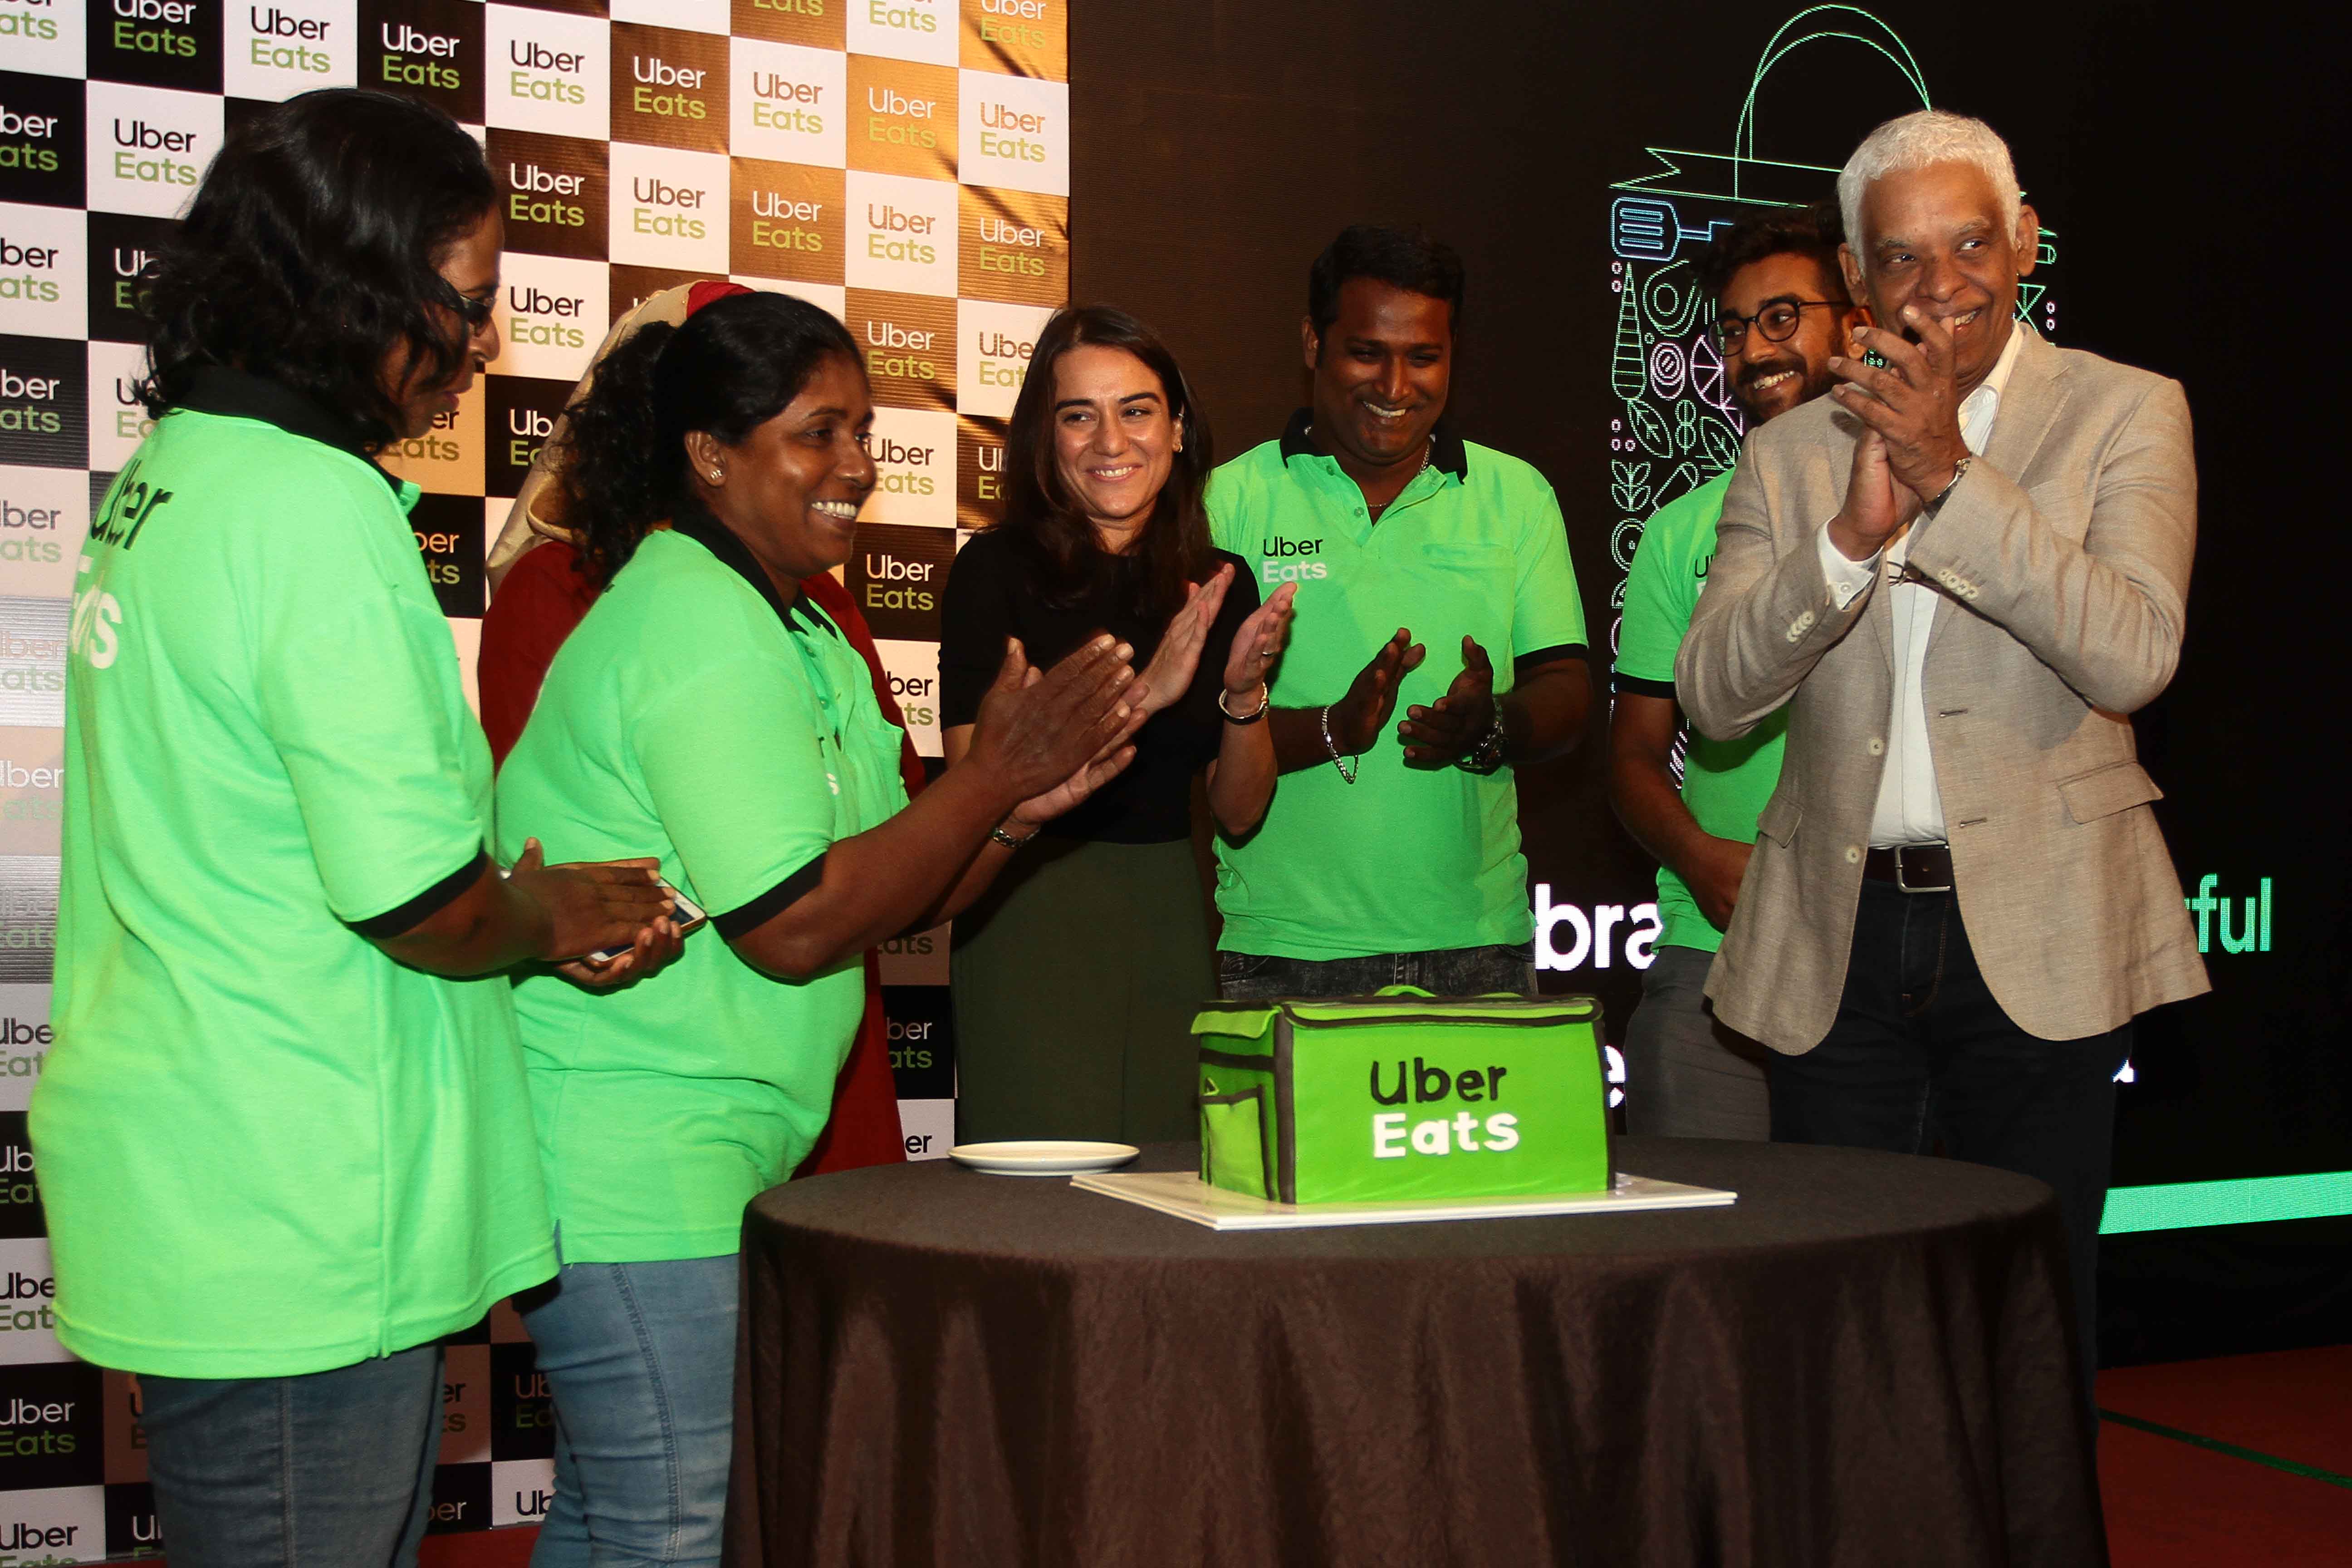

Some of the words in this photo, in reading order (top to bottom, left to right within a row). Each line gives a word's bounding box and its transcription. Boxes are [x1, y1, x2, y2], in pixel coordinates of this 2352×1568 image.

[0, 12, 58, 40] ats
[250, 5, 330, 41] Uber
[869, 1, 936, 33] Eats
[114, 22, 196, 57] Eats
[382, 22, 460, 58] Uber
[980, 17, 1045, 49] Eats
[250, 39, 331, 73] Eats
[511, 40, 585, 73] Uber
[382, 54, 460, 89] Eats
[634, 56, 706, 88] Uber
[510, 71, 585, 105] Eats
[754, 71, 823, 104] Uber
[634, 87, 706, 120] Eats
[754, 102, 823, 134] Eats
[868, 87, 936, 119] Uber
[0, 105, 58, 138] ber
[868, 116, 936, 148] Eats
[981, 103, 1045, 134] Uber
[115, 119, 196, 152] Uber
[980, 132, 1045, 162] Eats
[0, 143, 58, 172] ats
[115, 152, 197, 186] Eats
[510, 163, 585, 195] Uber
[634, 176, 706, 209] Uber
[510, 194, 585, 226] Eats
[753, 191, 822, 222] Uber
[868, 204, 936, 234] Uber
[633, 208, 706, 239] Eats
[753, 221, 823, 251] Eats
[980, 218, 1044, 247] Uber
[0, 238, 59, 269] ber
[868, 234, 936, 264] Eats
[980, 246, 1044, 276] Eats
[0, 274, 59, 302] ats
[510, 286, 584, 317] Uber
[510, 318, 584, 348] Eats
[867, 321, 935, 350] Uber
[979, 332, 1034, 359] Ube
[867, 350, 935, 380] Eats
[979, 361, 1027, 387] Eat
[1, 369, 60, 400] ber
[0, 406, 61, 433] ats
[432, 411, 459, 429] er
[510, 409, 553, 437] Ub
[0, 500, 61, 530] ber
[0, 537, 62, 563] ats
[1263, 536, 1323, 557] Uber
[428, 559, 460, 584] ts
[867, 554, 933, 581] Uber
[1263, 561, 1328, 583] Eats
[867, 584, 933, 610] Eats
[0, 632, 66, 658] ber
[2, 667, 64, 691] ats
[887, 671, 933, 696] ber
[904, 703, 933, 725] ts
[0, 759, 64, 788] ber
[0, 794, 63, 820] ats
[2184, 873, 2270, 953] ful
[0, 1018, 54, 1044] be
[887, 1016, 932, 1039] ber
[0, 1051, 43, 1077] at
[889, 1046, 932, 1068] ats
[1371, 1057, 1507, 1105] Uber
[905, 1135, 932, 1153] er
[1373, 1112, 1519, 1158] Eats
[0, 1272, 55, 1299] Ube
[516, 1375, 552, 1399] Ub
[428, 1501, 467, 1521] er
[516, 1490, 553, 1515] Ub
[0, 1523, 78, 1550] Uber
